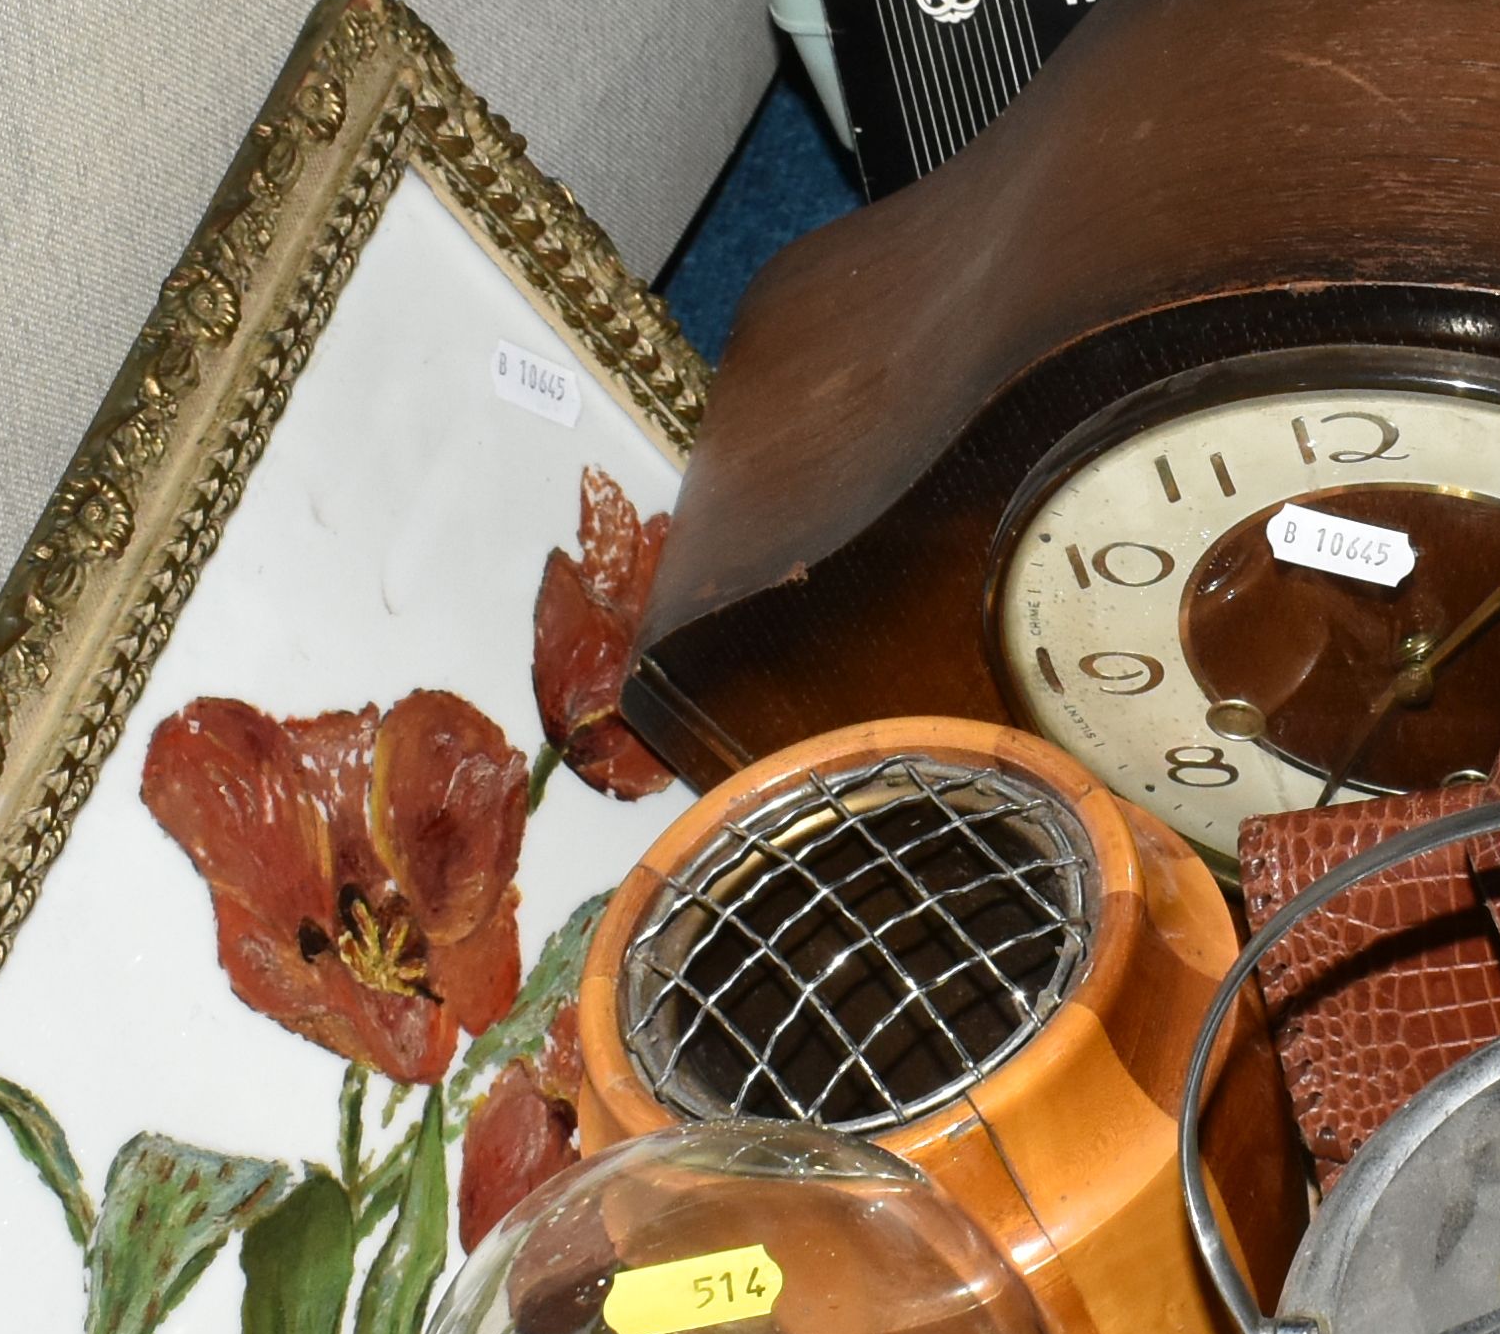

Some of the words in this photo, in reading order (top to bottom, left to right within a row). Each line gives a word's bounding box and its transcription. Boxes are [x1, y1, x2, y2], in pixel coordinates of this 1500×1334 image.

[499, 351, 507, 376] B
[519, 359, 566, 401] 10645
[1290, 411, 1411, 465] 12
[1153, 450, 1239, 504] 11
[1064, 541, 1176, 589] 10
[1283, 520, 1297, 544] B
[1316, 527, 1392, 566] 10645
[1029, 600, 1042, 637] CHIME
[1078, 651, 1165, 697] 9
[1064, 703, 1098, 740] SILENT
[1164, 744, 1240, 790] 8
[691, 1263, 768, 1310] 514
